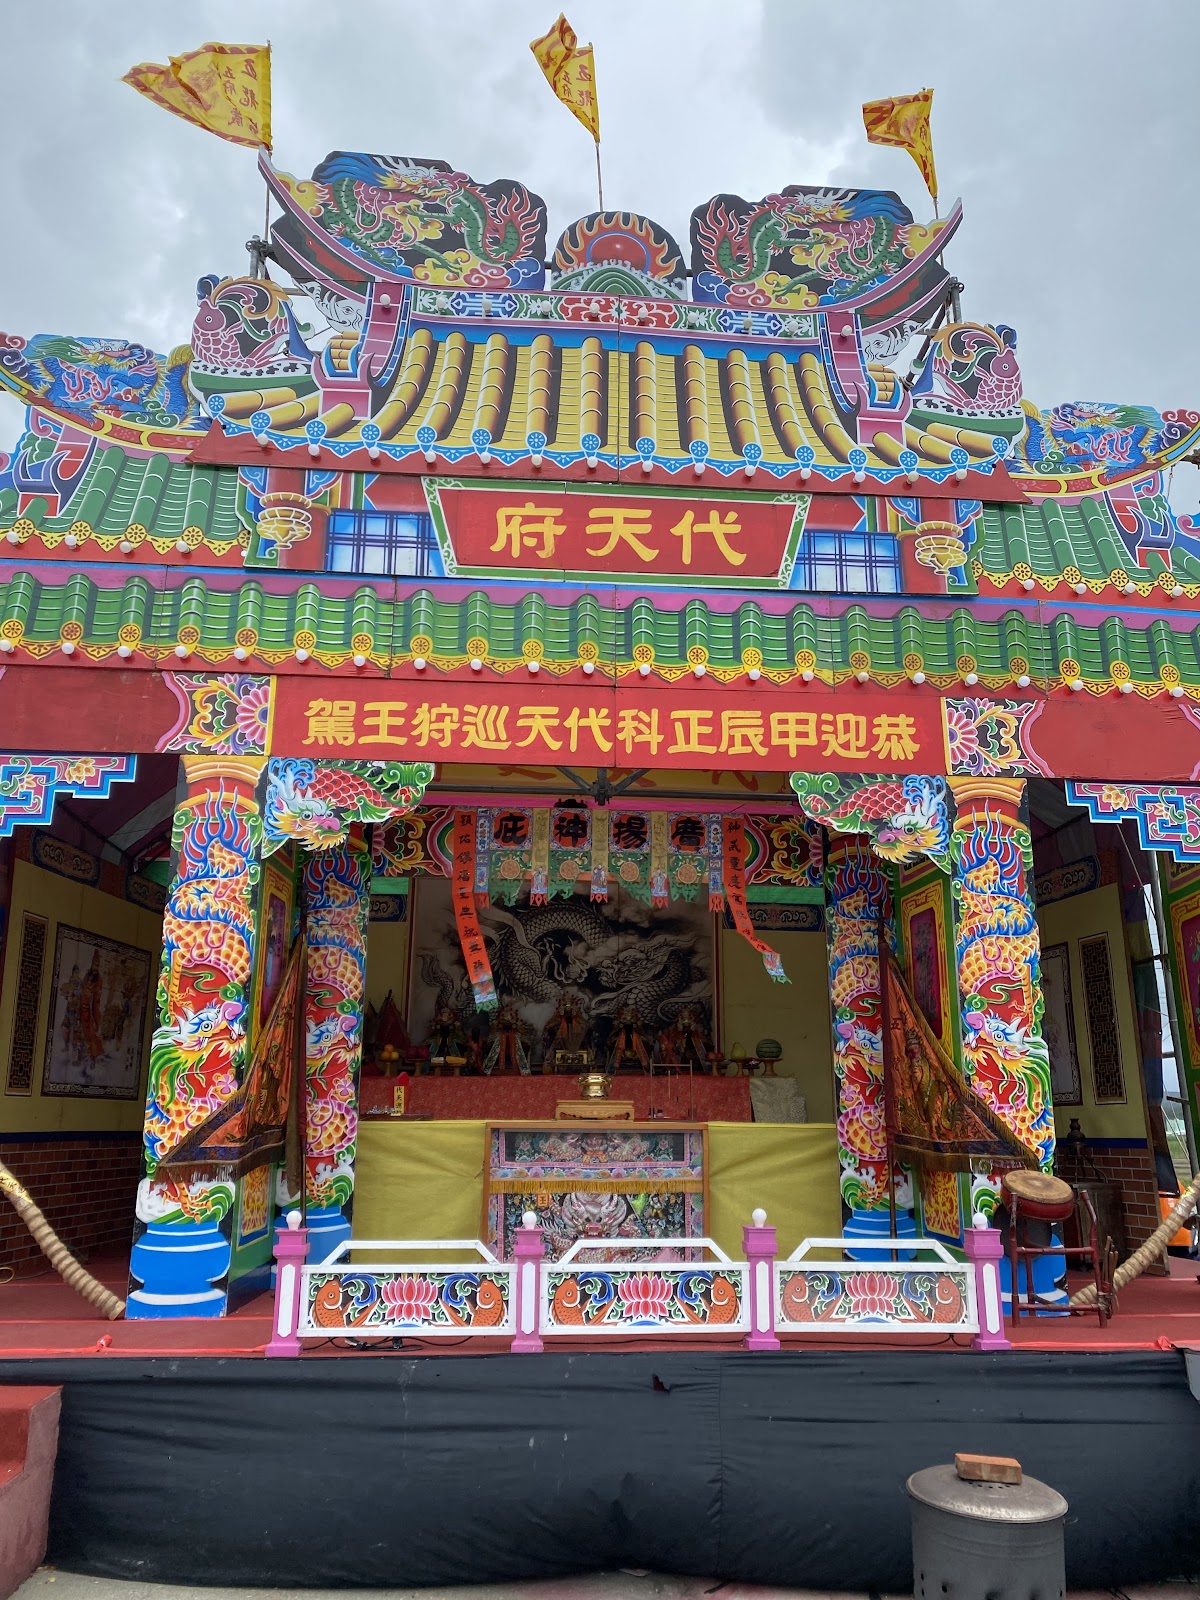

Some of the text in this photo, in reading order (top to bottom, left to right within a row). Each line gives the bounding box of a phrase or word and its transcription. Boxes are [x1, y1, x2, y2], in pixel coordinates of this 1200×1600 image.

[489, 501, 748, 566] 代天府
[301, 697, 921, 761] 恭迎甲辰正科代天巡狩王駕
